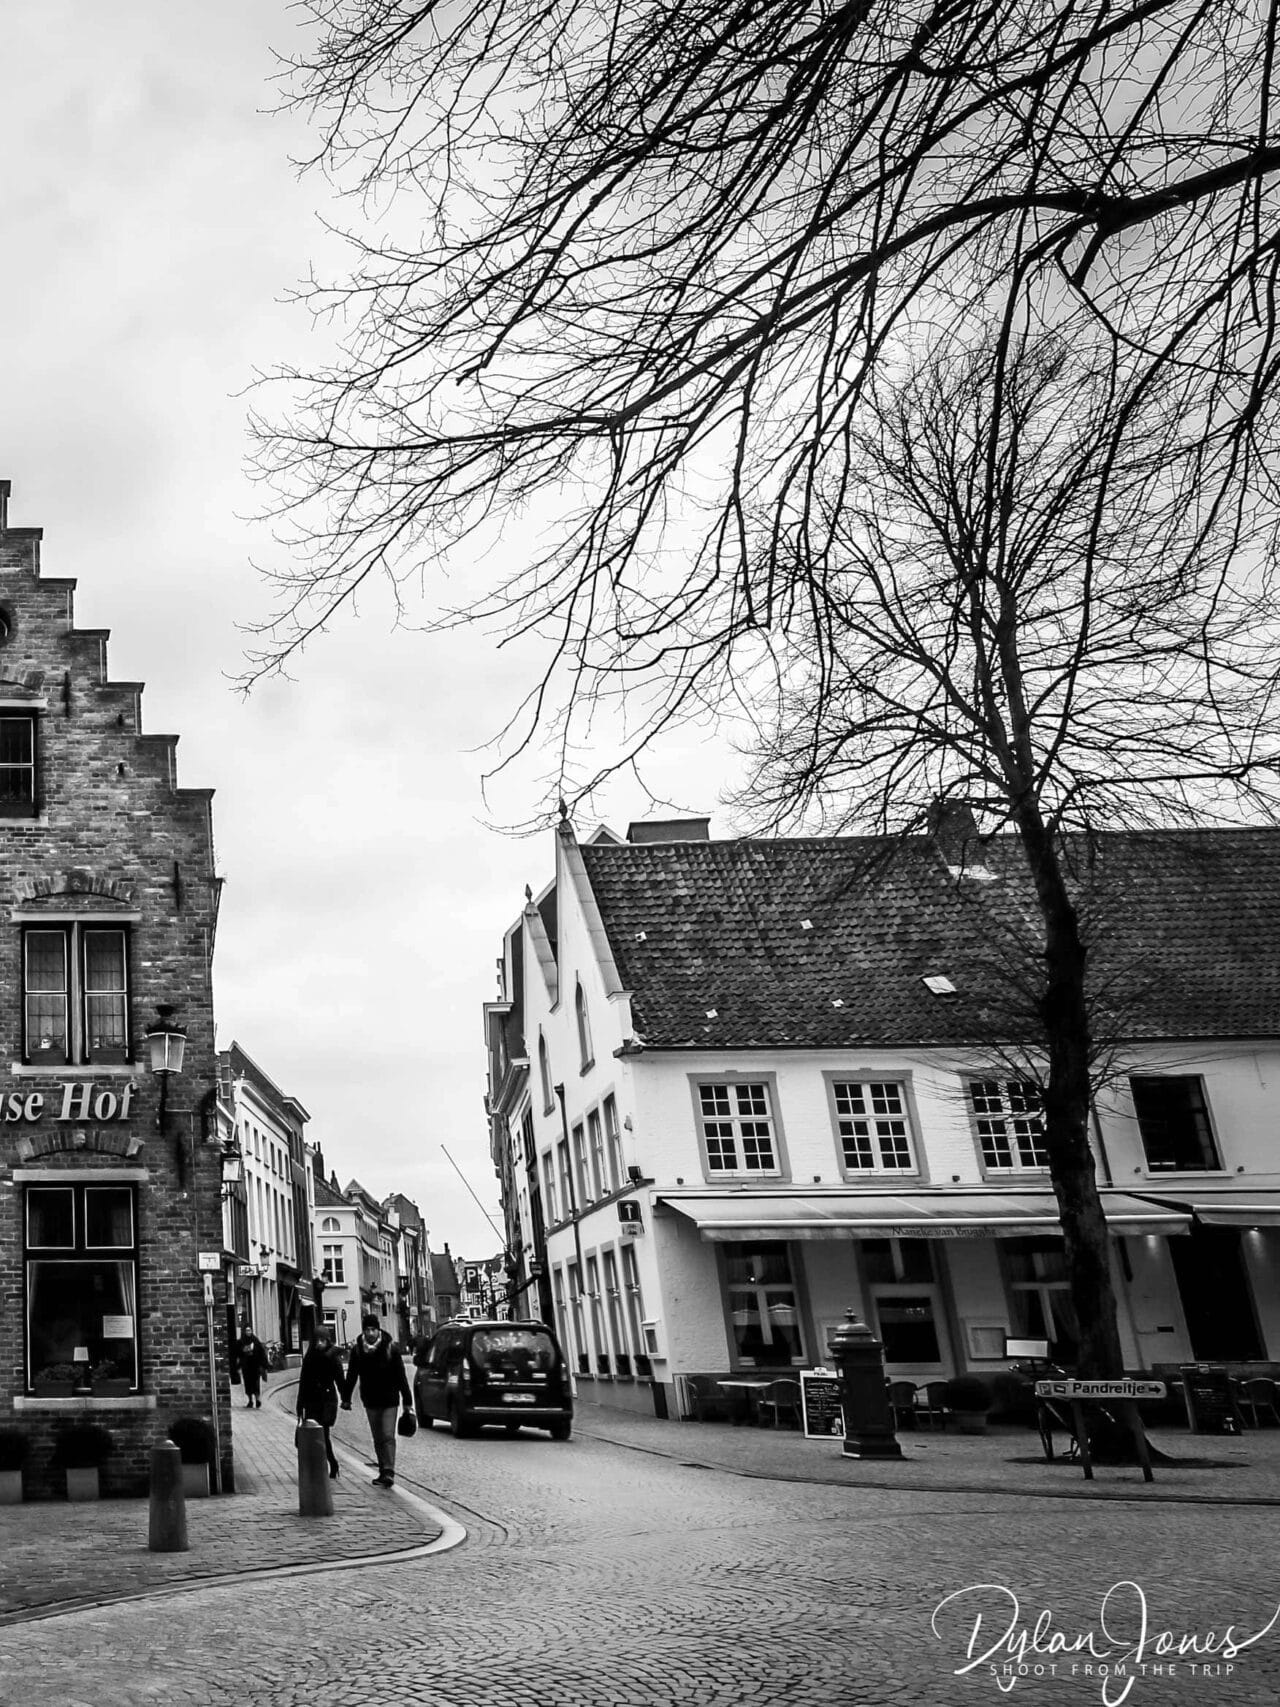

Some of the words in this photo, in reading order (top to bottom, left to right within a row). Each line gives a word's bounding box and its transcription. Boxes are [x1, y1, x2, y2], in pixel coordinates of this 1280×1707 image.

[56, 1083, 138, 1121] Hof
[467, 1269, 476, 1283] P
[1073, 1383, 1145, 1396] Pandreitje
